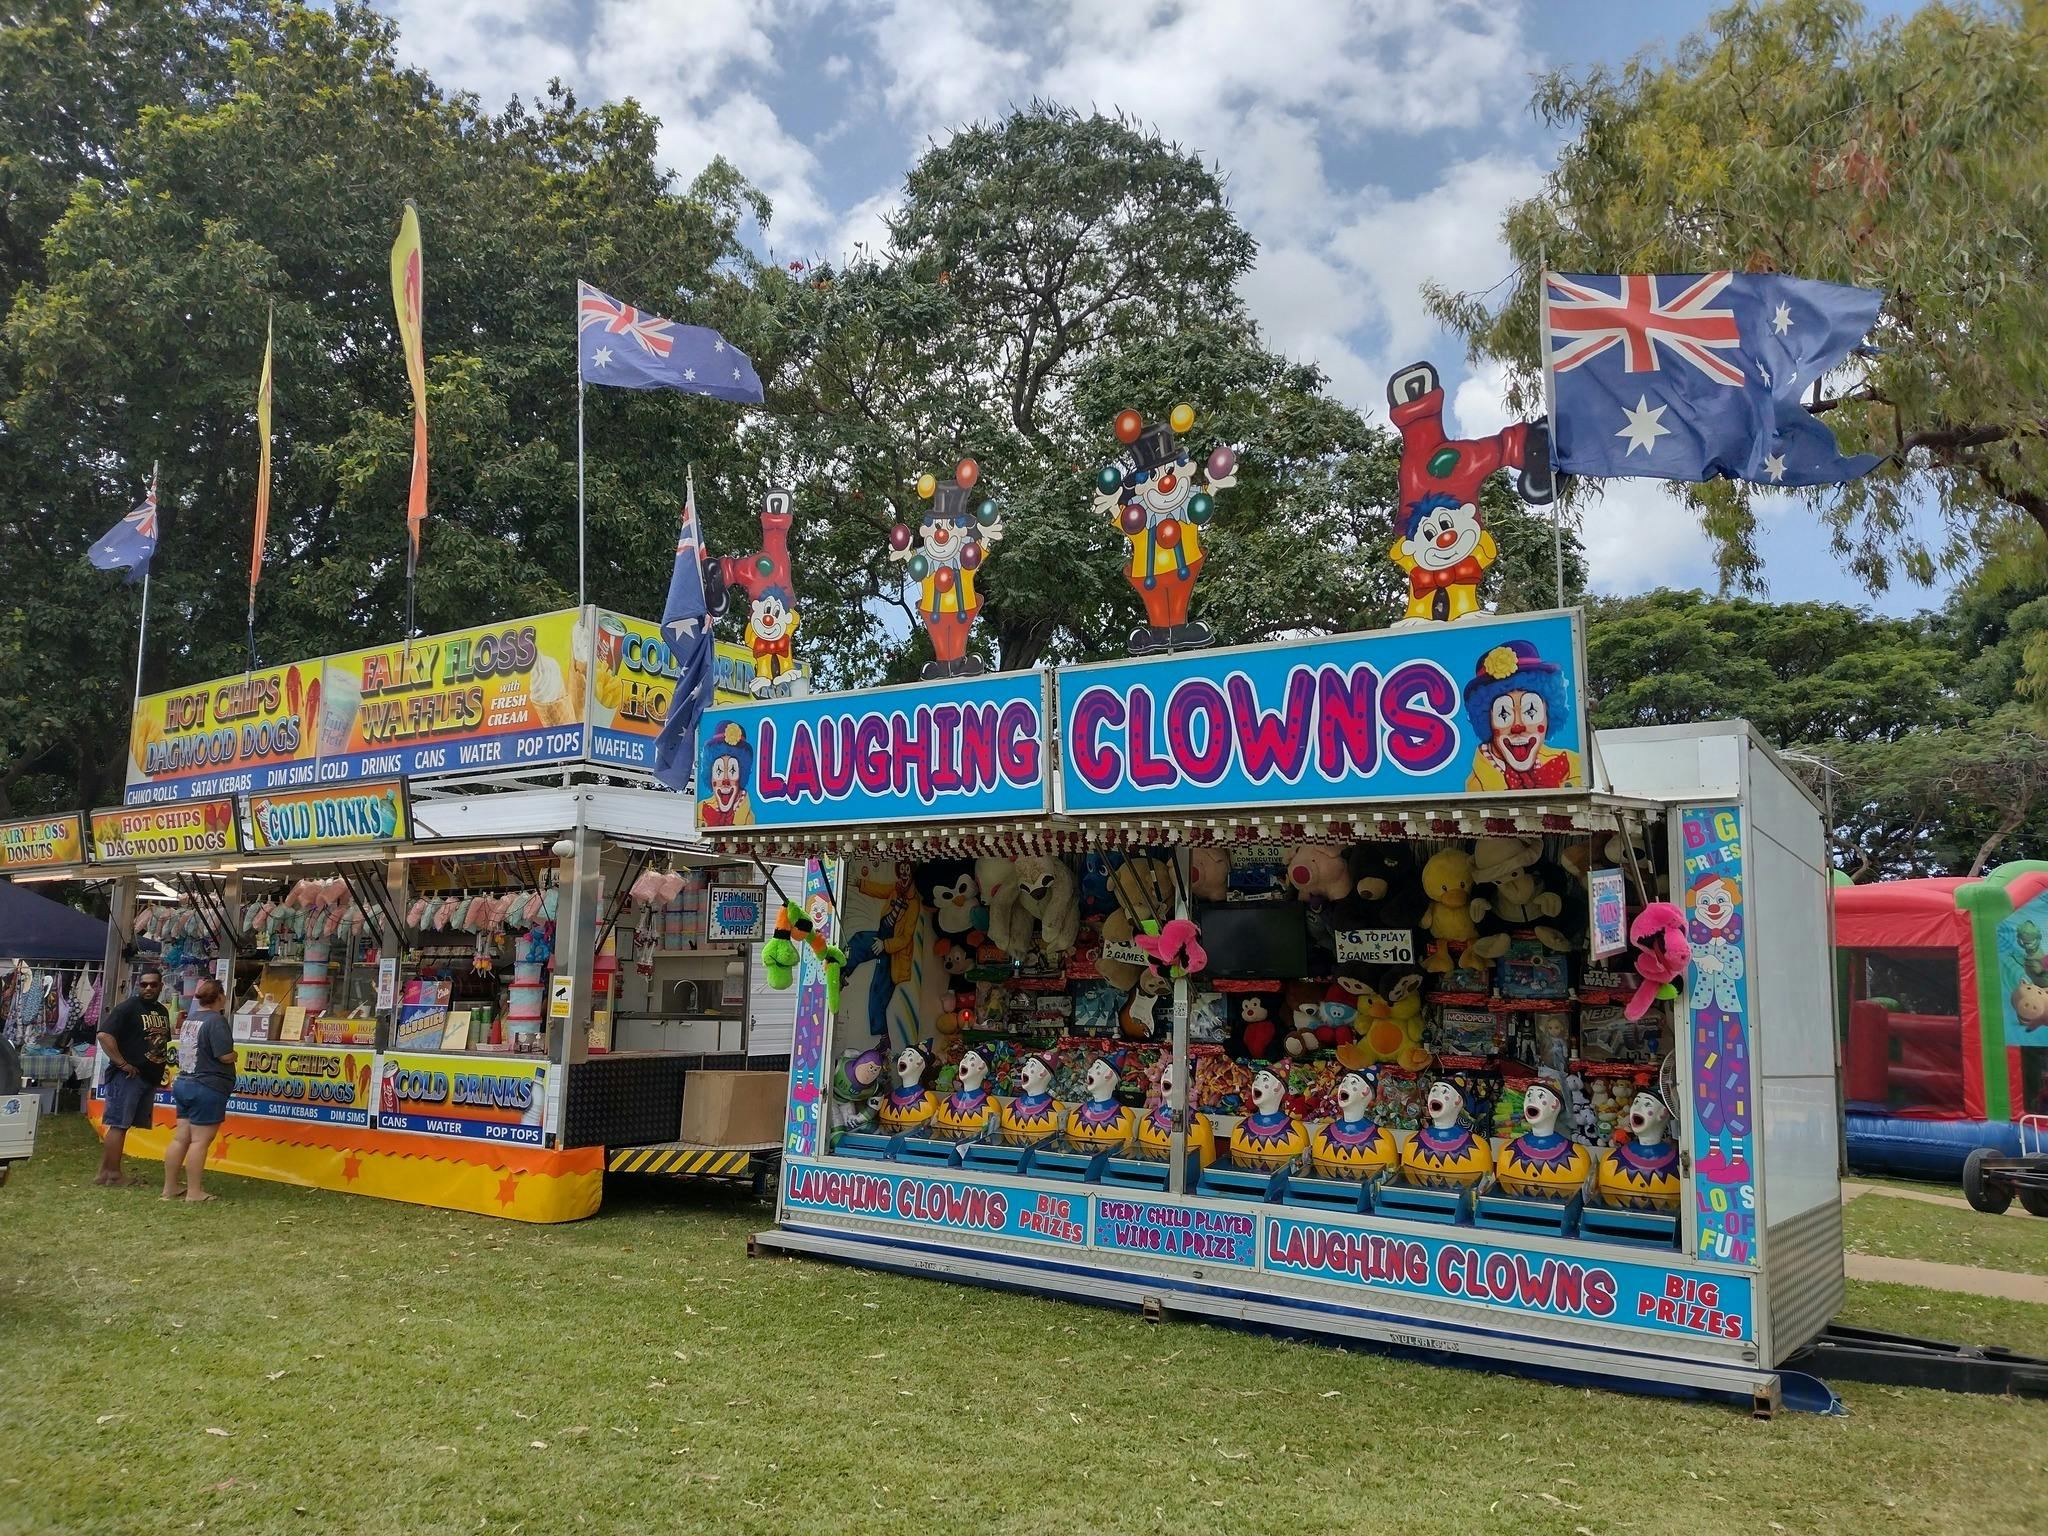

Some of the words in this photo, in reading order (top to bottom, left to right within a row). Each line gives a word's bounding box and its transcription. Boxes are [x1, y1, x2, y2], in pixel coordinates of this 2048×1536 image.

[361, 644, 438, 697] FAIRY
[443, 626, 537, 682] FLOSS
[499, 679, 521, 693] with
[164, 691, 208, 732] HOT
[214, 674, 280, 721] CHIPS
[491, 694, 527, 710] FRESH
[620, 679, 673, 721] HO
[360, 687, 483, 743] WAFFLES
[487, 710, 528, 726] CREAM
[144, 725, 239, 774] DAGWOOD
[241, 715, 300, 755] DOGS
[758, 699, 1041, 804] LAUGHING
[1070, 659, 1460, 792] CLOWNS
[321, 761, 348, 780] COLD
[361, 755, 401, 775] DRINKS
[415, 749, 445, 769] CANS
[460, 742, 500, 763] WATER
[517, 737, 543, 756] POP
[546, 731, 579, 753] TOPS
[594, 736, 644, 761] WAFFLES
[127, 789, 152, 805] CHIKO
[153, 786, 177, 800] ROLLS
[191, 780, 217, 797] SATAY
[218, 774, 251, 792] KEBABS
[267, 770, 287, 787] DIM
[289, 765, 313, 783] SIMS
[121, 813, 154, 834] HOT
[156, 808, 201, 830] CHIPS
[268, 802, 311, 841] COLD
[312, 796, 381, 838] DRINKS
[1683, 812, 1739, 849] BIG
[0, 827, 27, 845] AIRY
[31, 823, 65, 841] FLOSS
[106, 835, 182, 858] DAGWOOD
[183, 831, 226, 851] DOGS
[7, 842, 53, 862] DONUTS
[1247, 848, 1253, 856] 5
[1257, 848, 1265, 856] &
[1268, 848, 1279, 856] 30
[1685, 843, 1741, 874] PRIZES
[713, 892, 739, 902] EVERY
[741, 892, 763, 903] CHILD
[723, 906, 753, 921] WINS
[720, 926, 726, 935] A
[729, 926, 754, 936] PRIZE
[1341, 931, 1361, 944] $6
[1365, 933, 1379, 942] TO
[1380, 933, 1406, 942] PLAY
[1114, 951, 1145, 962] GAMES
[1340, 952, 1345, 960] 2
[1347, 951, 1380, 960] GAMES
[1383, 948, 1411, 961] $10
[1446, 1013, 1493, 1023] MONOPOLY
[1581, 1006, 1621, 1021] NERF
[244, 1051, 282, 1072] HOT
[286, 1054, 340, 1077] CHIPS
[309, 1081, 355, 1102] DOGS
[394, 1069, 449, 1102] COLD
[452, 1073, 533, 1110] DRINKS
[236, 1101, 258, 1112] ROLLS
[269, 1104, 290, 1115] SATAY
[291, 1106, 318, 1118] KEBABS
[330, 1110, 346, 1120] DIM
[347, 1112, 365, 1123] SIMS
[382, 1116, 407, 1128] CANS
[426, 1120, 462, 1133] WATER
[486, 1126, 508, 1138] POP
[510, 1128, 539, 1141] TOPS
[788, 1132, 812, 1156] FUN
[788, 1165, 892, 1213] LAUGHING
[896, 1180, 1009, 1231] CLOWNS
[1037, 1193, 1070, 1219] BIG
[1696, 1185, 1754, 1213] LOTS
[1018, 1209, 1084, 1244] PRIZES
[1100, 1201, 1144, 1223] EVERY
[1147, 1206, 1192, 1228] CHILD
[1195, 1211, 1253, 1237] PLAYER
[1726, 1212, 1754, 1235] OF
[1115, 1223, 1161, 1250] WINS
[1165, 1230, 1177, 1253] A
[1181, 1230, 1236, 1259] PRIZE
[1700, 1228, 1749, 1263] FUN
[1267, 1218, 1430, 1286] LAUGHING
[1435, 1244, 1617, 1318] CLOWNS
[1664, 1273, 1720, 1309] BIG
[1636, 1292, 1744, 1340] PRIZES
